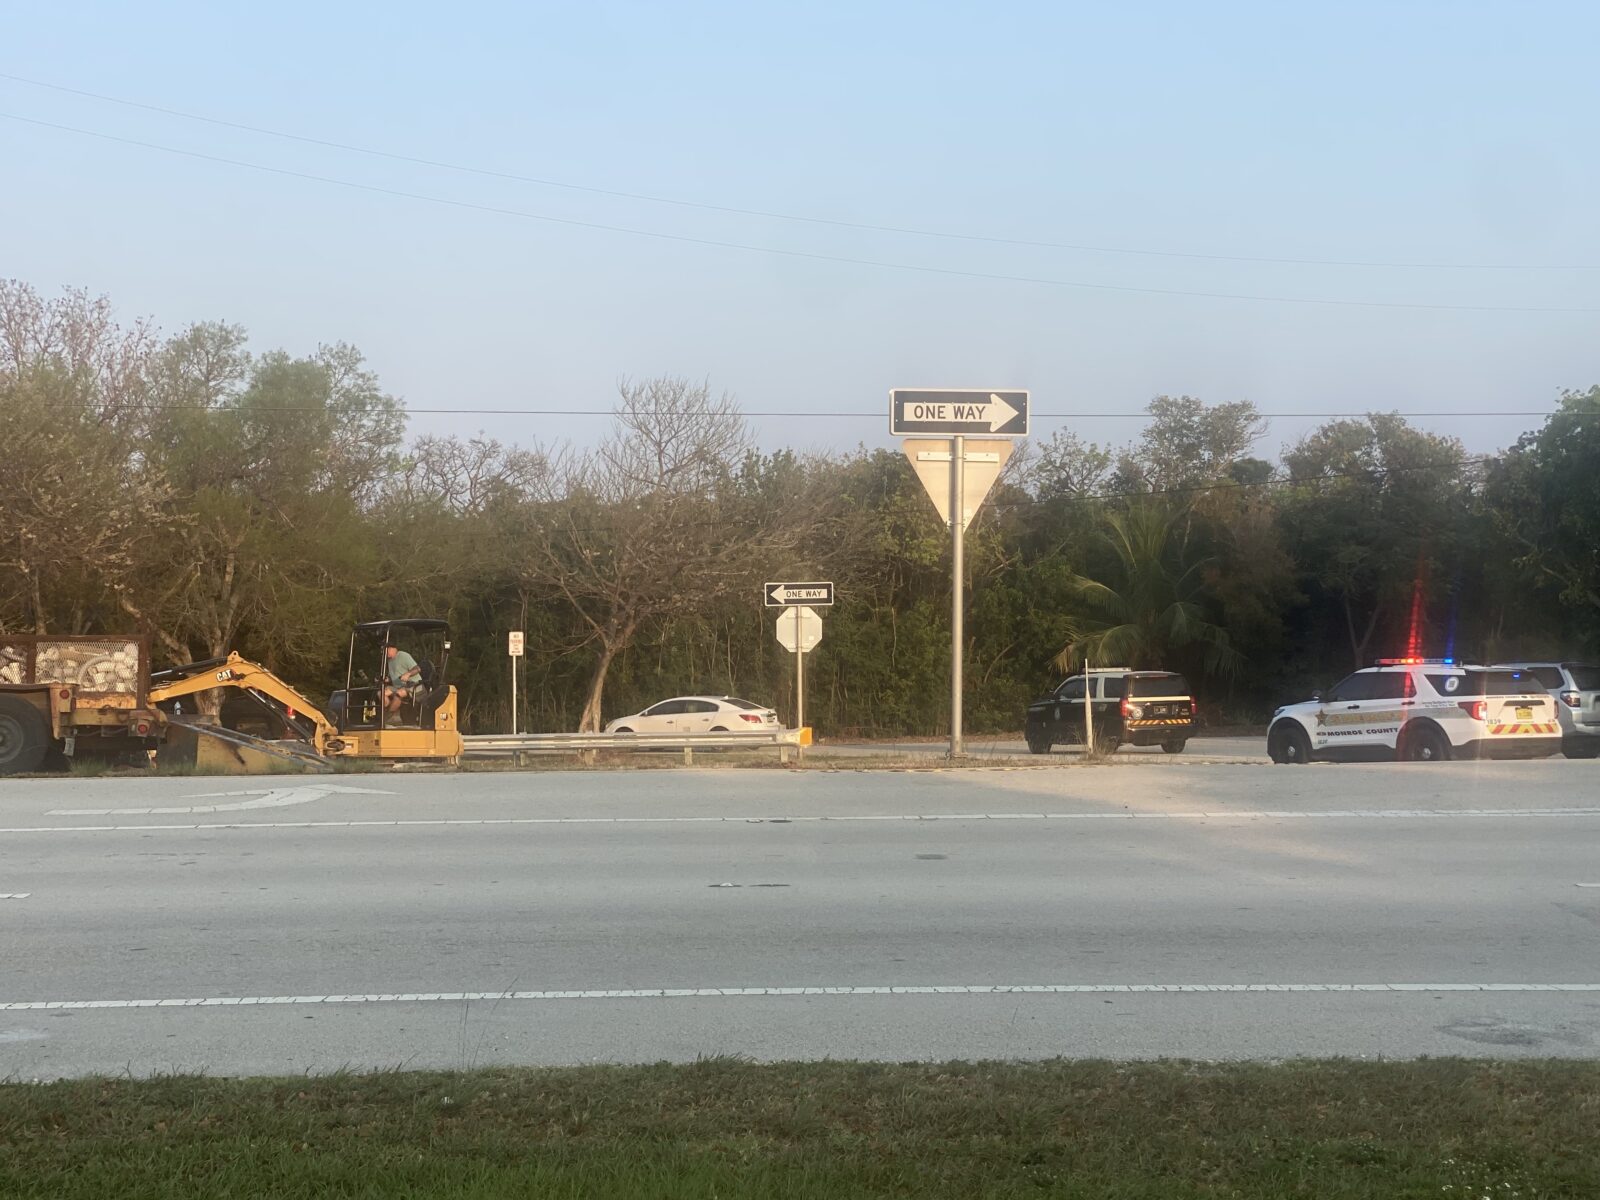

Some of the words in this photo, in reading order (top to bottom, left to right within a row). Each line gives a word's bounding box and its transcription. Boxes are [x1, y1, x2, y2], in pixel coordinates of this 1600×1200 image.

[914, 405, 946, 419] ONE
[953, 405, 986, 420] WAY
[806, 590, 822, 598] WAY
[216, 669, 232, 682] CAT
[1327, 729, 1363, 737] MONROE
[1366, 727, 1398, 735] COUNTY
